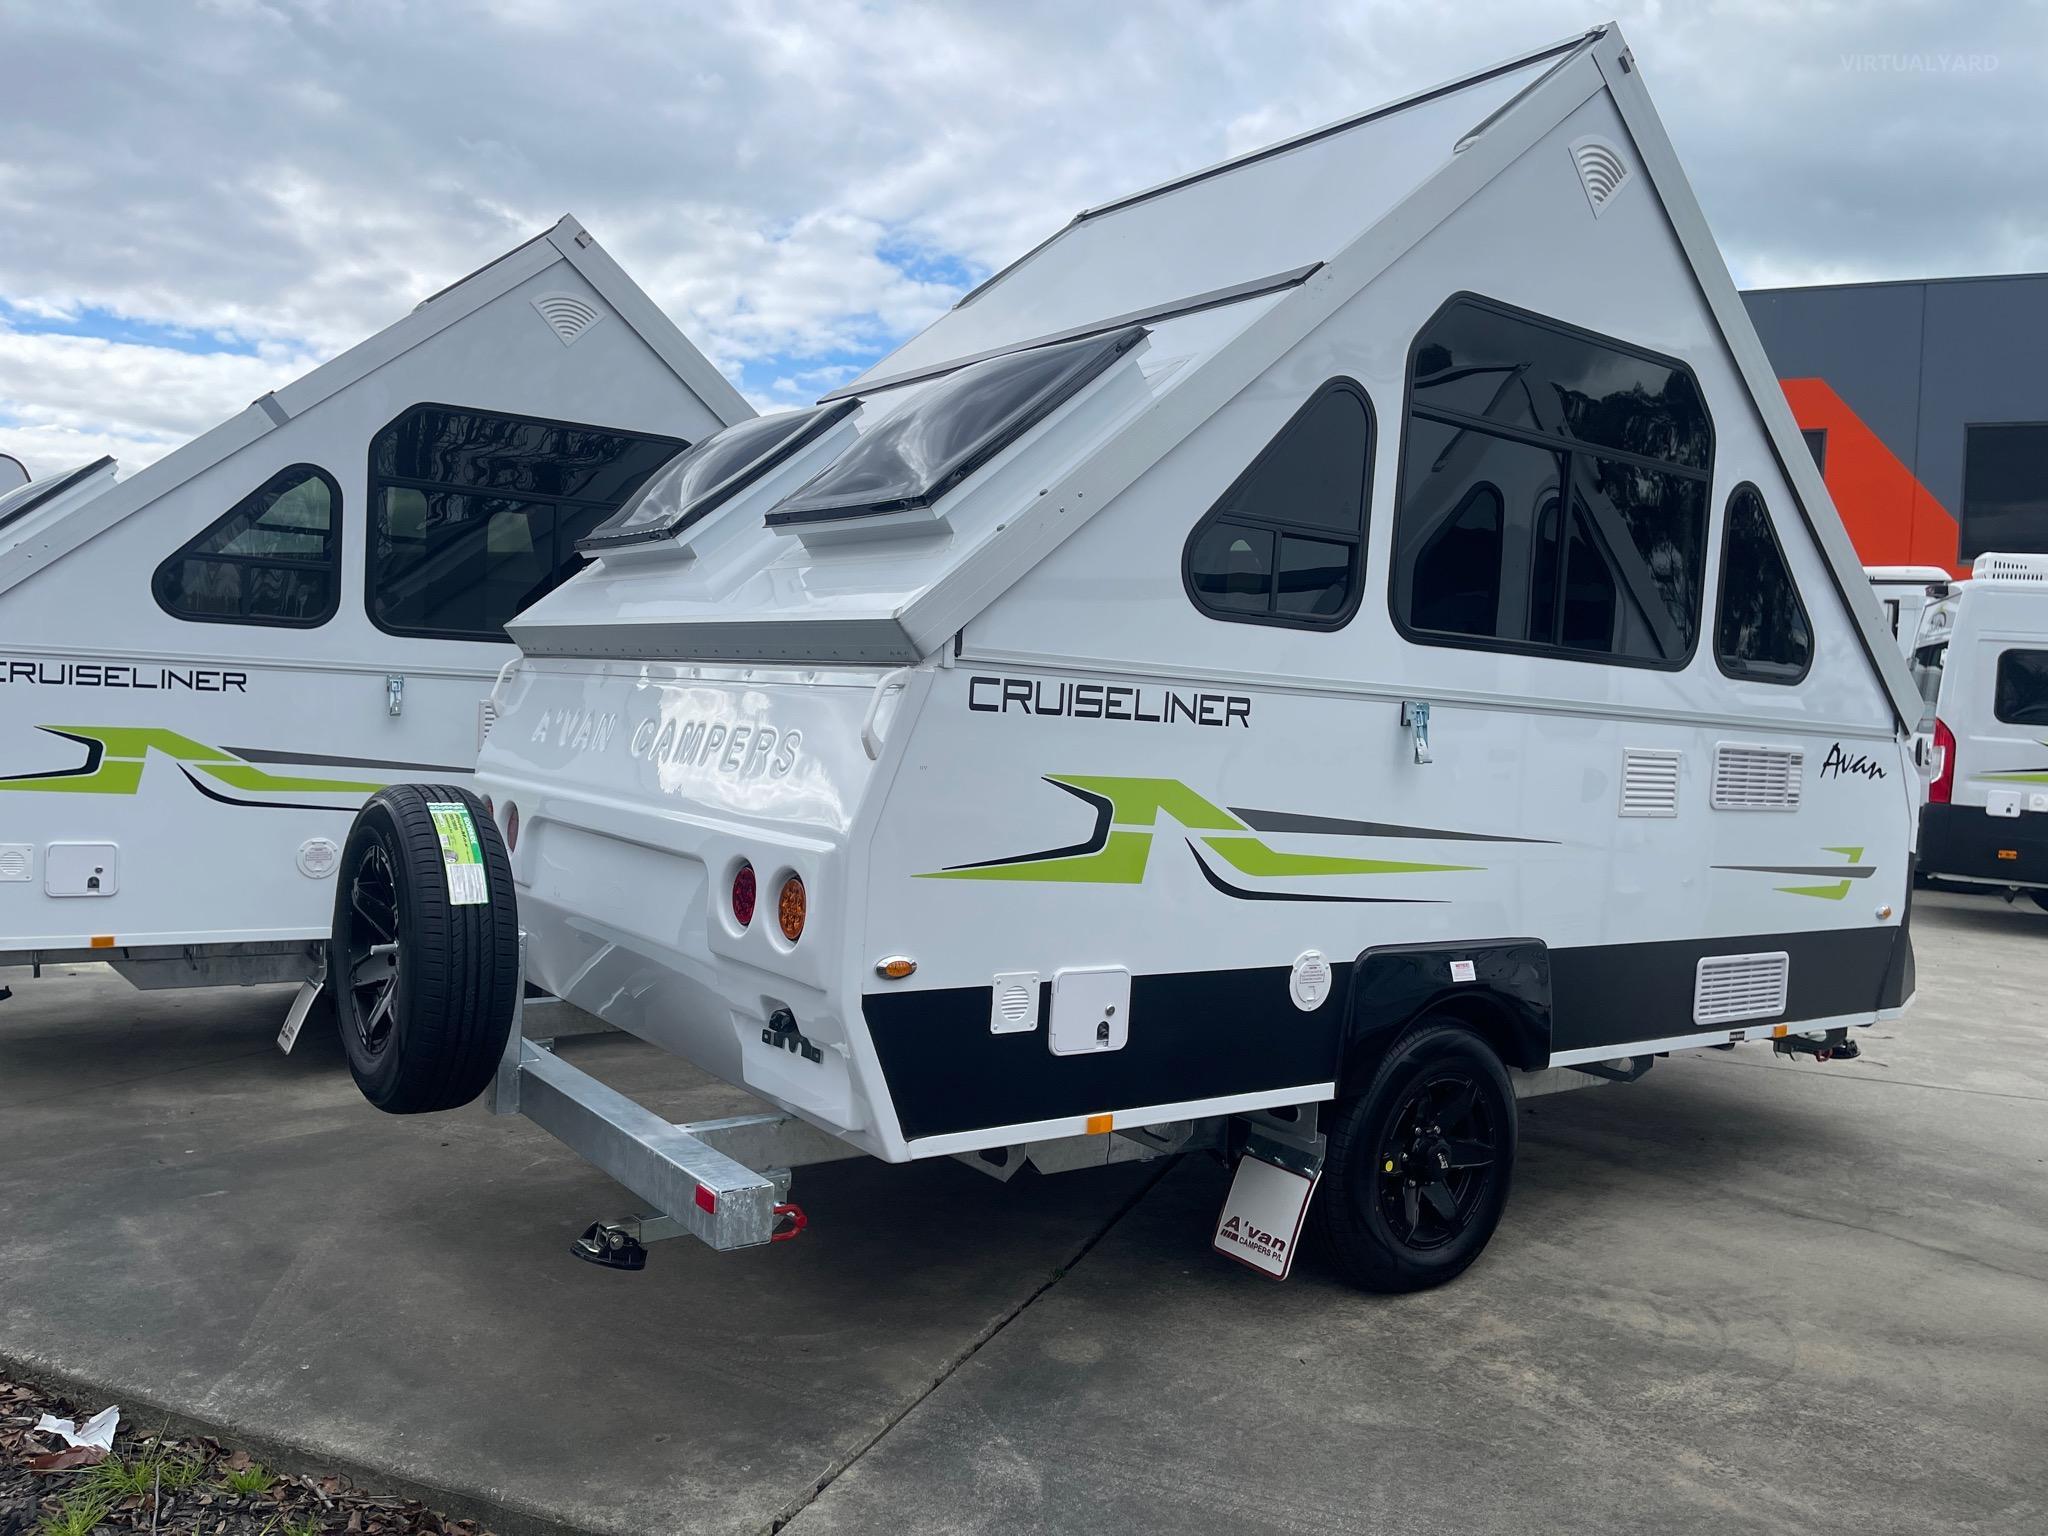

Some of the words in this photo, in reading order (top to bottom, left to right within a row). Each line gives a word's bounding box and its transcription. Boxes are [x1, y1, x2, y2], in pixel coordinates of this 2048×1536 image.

[0, 662, 247, 693] RUISELINER
[968, 676, 1250, 728] CRUISELINER
[530, 708, 617, 752] A'VAN
[630, 717, 803, 778] CAMPERS
[1820, 742, 1887, 780] Avan
[1224, 1215, 1287, 1252] A'van
[1239, 1236, 1271, 1257] CAMPERS
